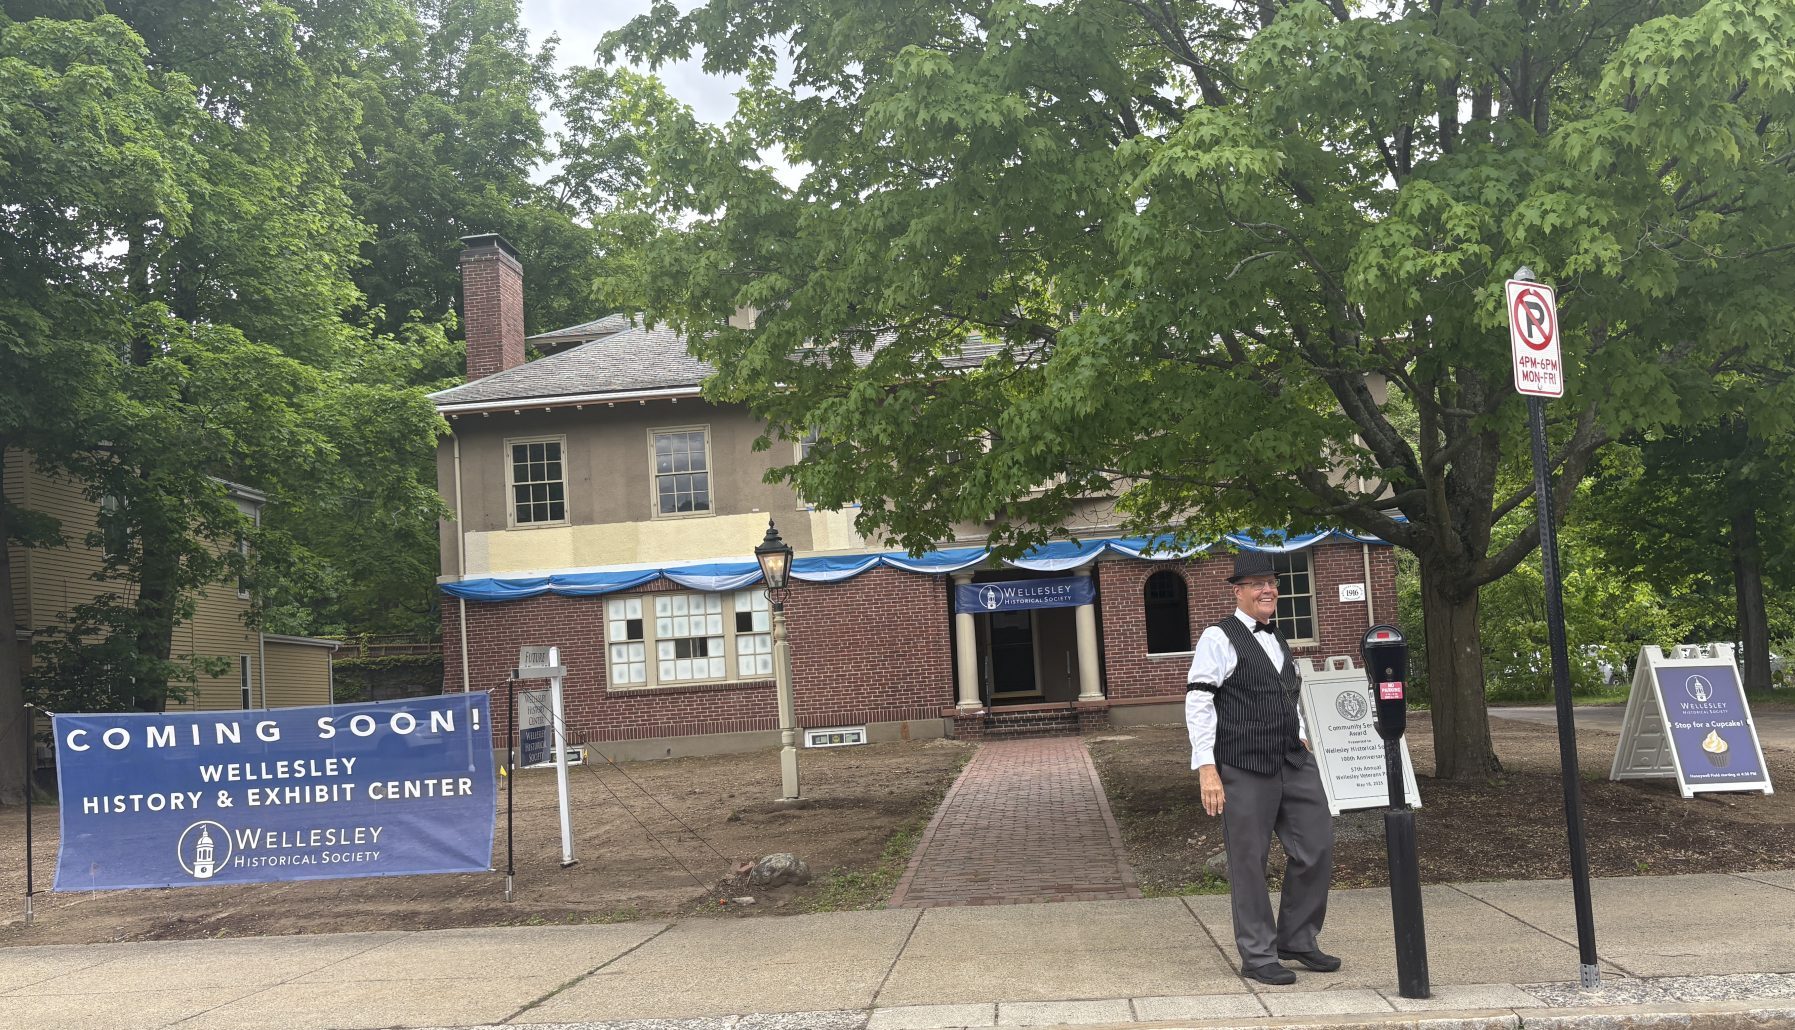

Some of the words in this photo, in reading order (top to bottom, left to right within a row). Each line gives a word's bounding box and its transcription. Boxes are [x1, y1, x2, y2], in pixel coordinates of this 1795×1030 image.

[1519, 356, 1557, 371] 4PM-6PM
[1522, 370, 1556, 384] MON-FRI
[1004, 585, 1071, 597] WELLESLEY
[66, 720, 280, 752] COMING
[317, 708, 480, 739] SOON!
[1711, 720, 1744, 728] Cupcake!
[200, 757, 357, 782] WELLESLEY
[83, 791, 202, 814] HISTORY
[216, 790, 234, 808] &
[248, 784, 355, 806] EXHIBIT
[368, 778, 472, 800] CENTER
[235, 826, 383, 849] WELLESLEY
[234, 854, 317, 868] HISTORICAL
[322, 852, 380, 863] SOCIETY
